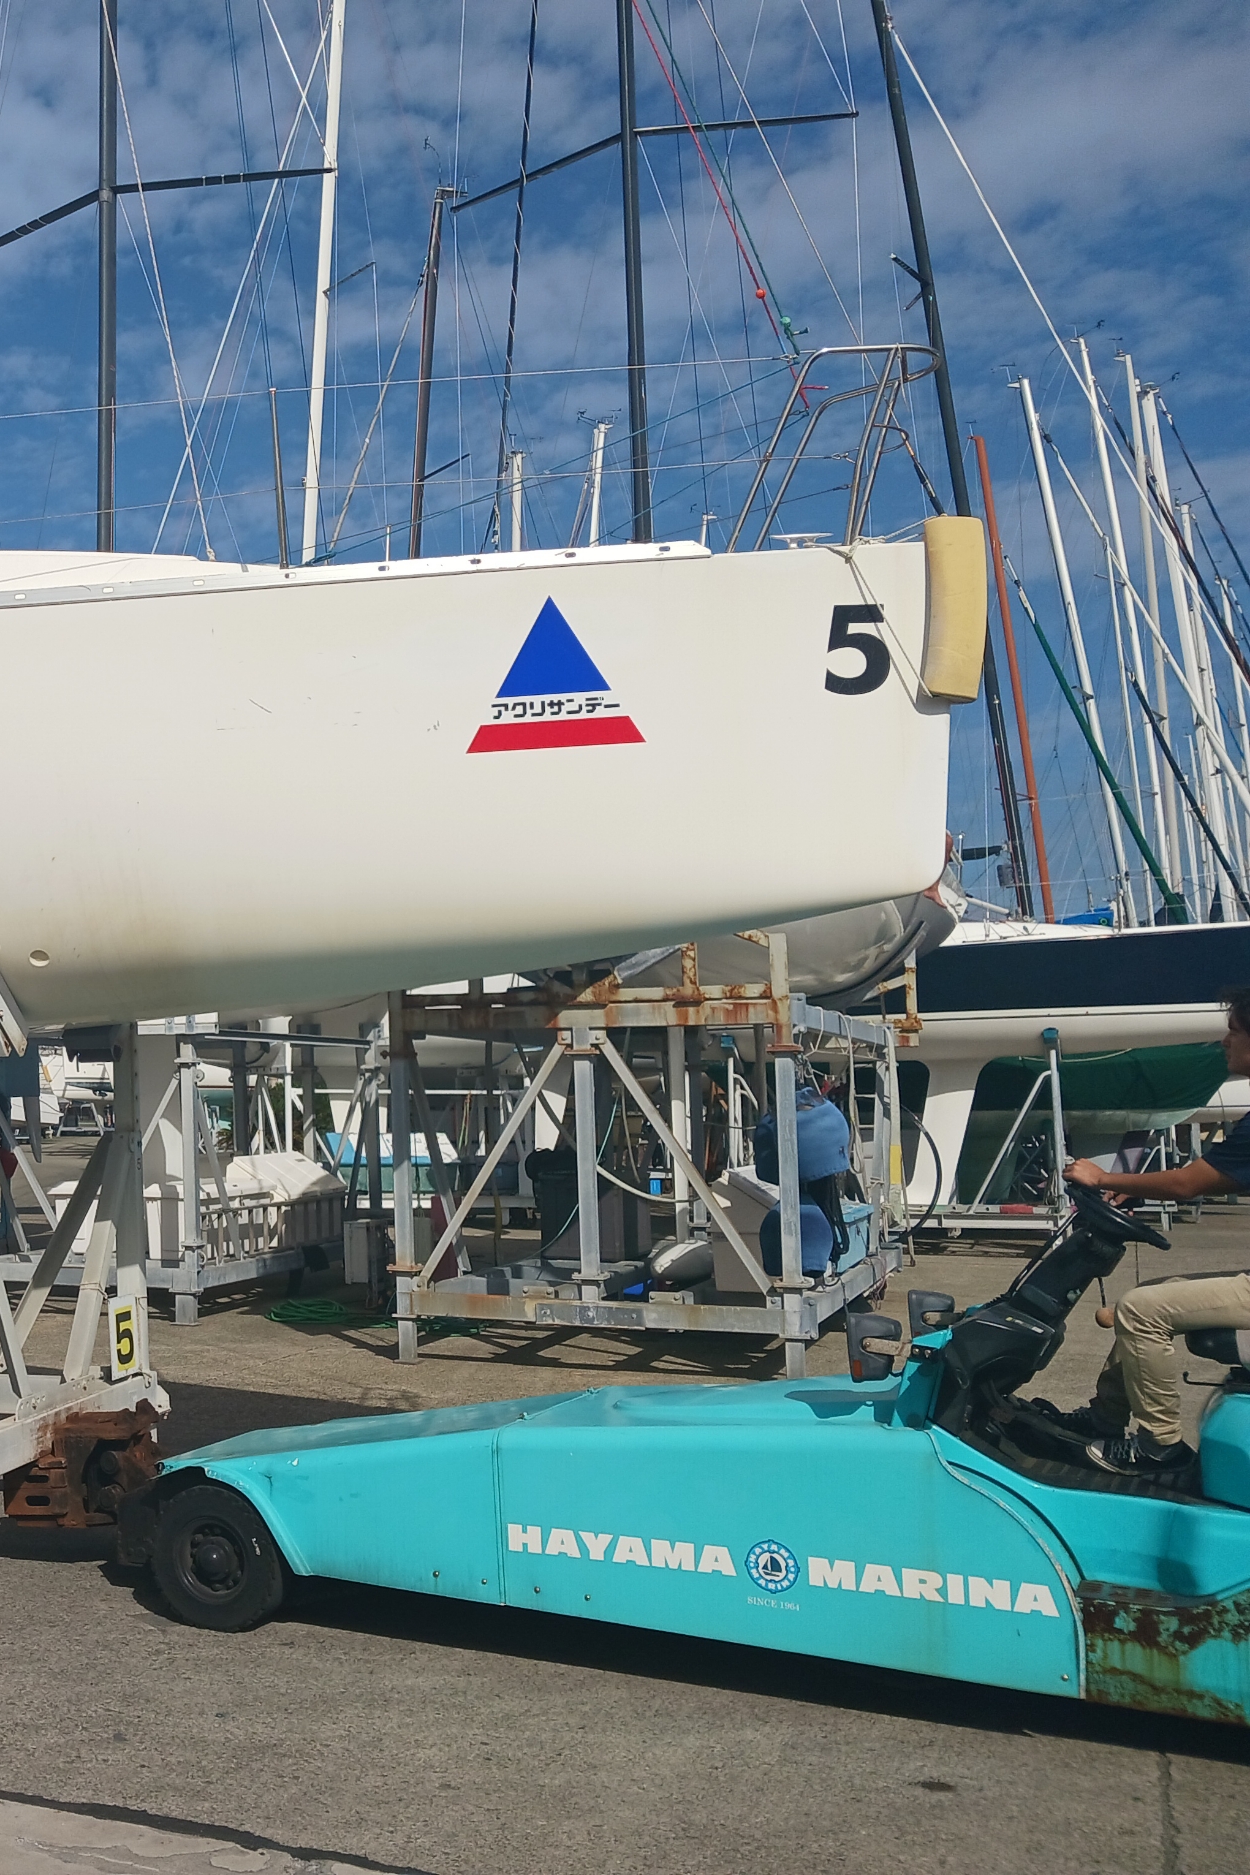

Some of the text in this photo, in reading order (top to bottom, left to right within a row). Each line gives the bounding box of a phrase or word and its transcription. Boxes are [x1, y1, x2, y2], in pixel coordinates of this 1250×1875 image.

[825, 604, 890, 695] 5
[491, 697, 620, 719] アクリサンデー
[115, 1310, 134, 1365] 5
[750, 1544, 795, 1566] HAYAMA
[507, 1523, 1061, 1618] HAYAMA MARINA
[751, 1569, 795, 1590] MARINA
[748, 1597, 800, 1612] SINCE 1964
